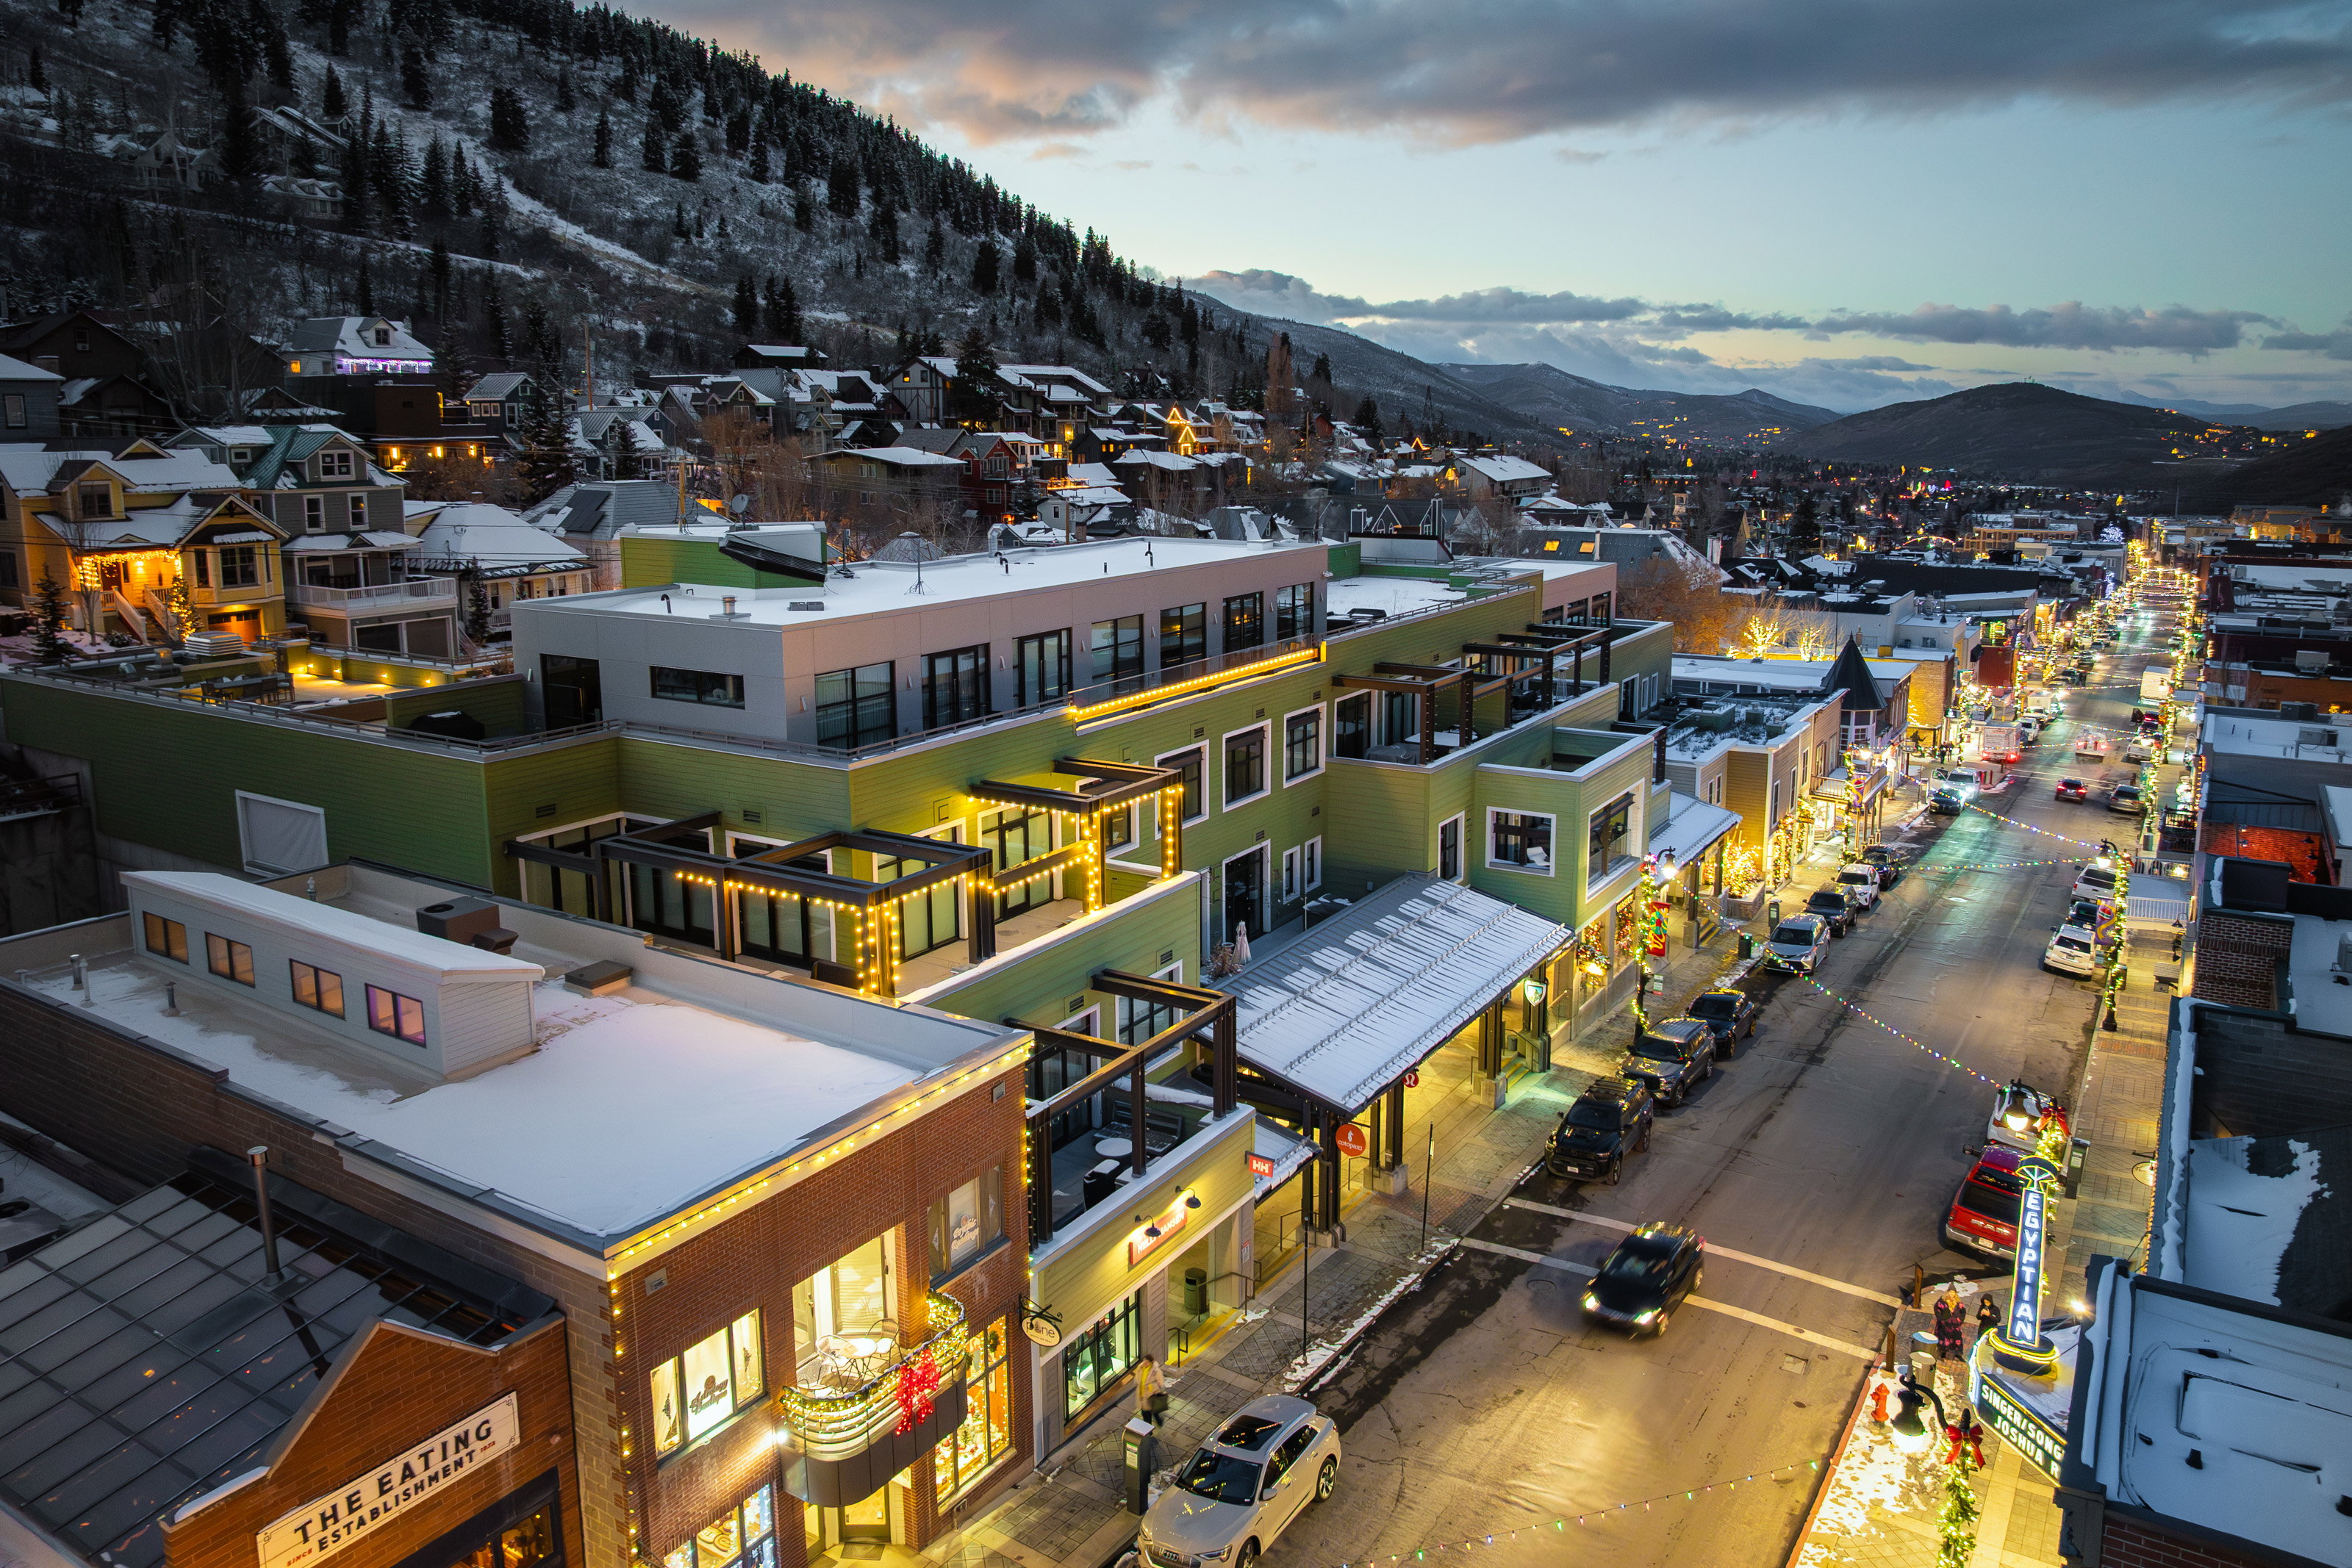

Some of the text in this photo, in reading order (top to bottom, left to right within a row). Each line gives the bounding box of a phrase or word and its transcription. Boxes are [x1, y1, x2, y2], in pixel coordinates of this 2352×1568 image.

[1971, 1218, 2012, 1235] RAM
[2015, 1192, 2041, 1340] EGYPTIAN
[1981, 1384, 2065, 1461] SINGER/SONG
[1994, 1415, 2045, 1466] JOSHUA
[286, 1547, 312, 1567] SINCE
[318, 1449, 476, 1553] ESTABLISHMENT
[294, 1418, 492, 1544] THE EATING
